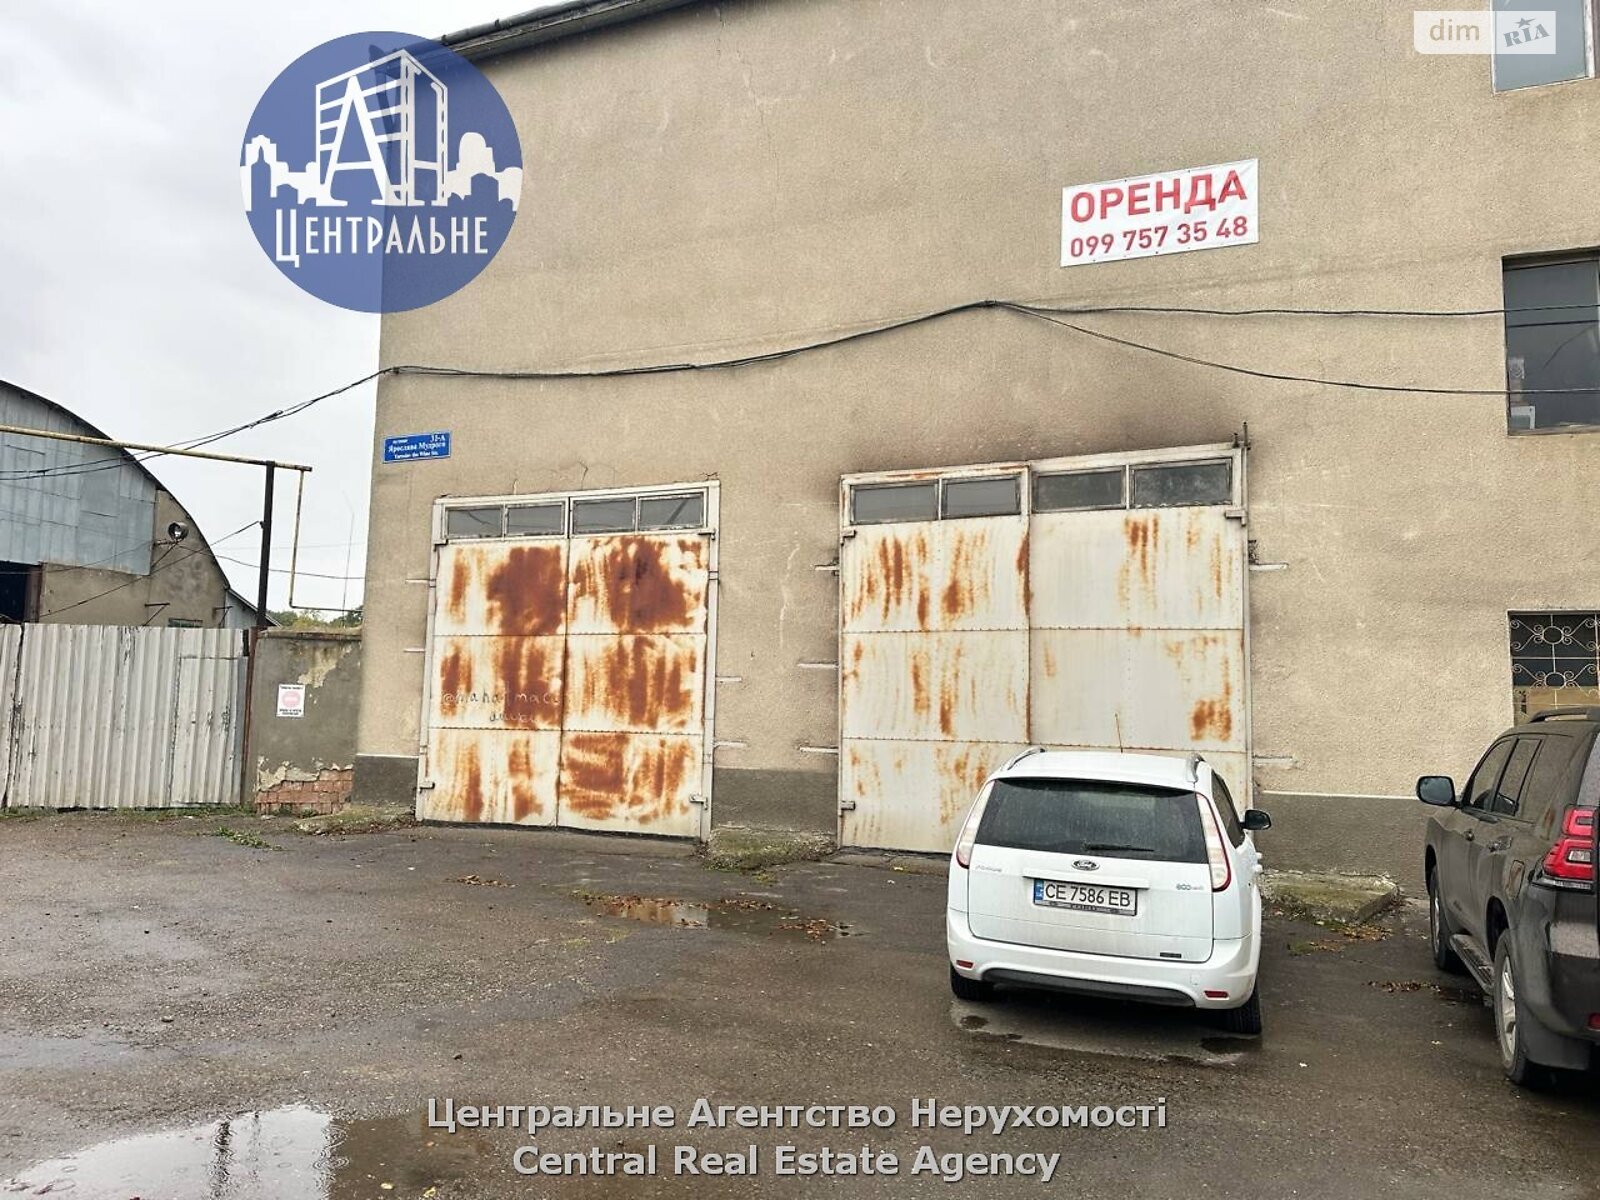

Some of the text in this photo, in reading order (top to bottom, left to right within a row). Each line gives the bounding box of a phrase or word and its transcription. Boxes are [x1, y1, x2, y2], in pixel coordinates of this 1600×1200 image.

[1070, 169, 1248, 223] ОРЕНДА
[1070, 215, 1248, 258] 099 757 35 48
[1045, 883, 1067, 901] CE
[1070, 885, 1105, 905] 7586
[1108, 890, 1131, 907] EB
